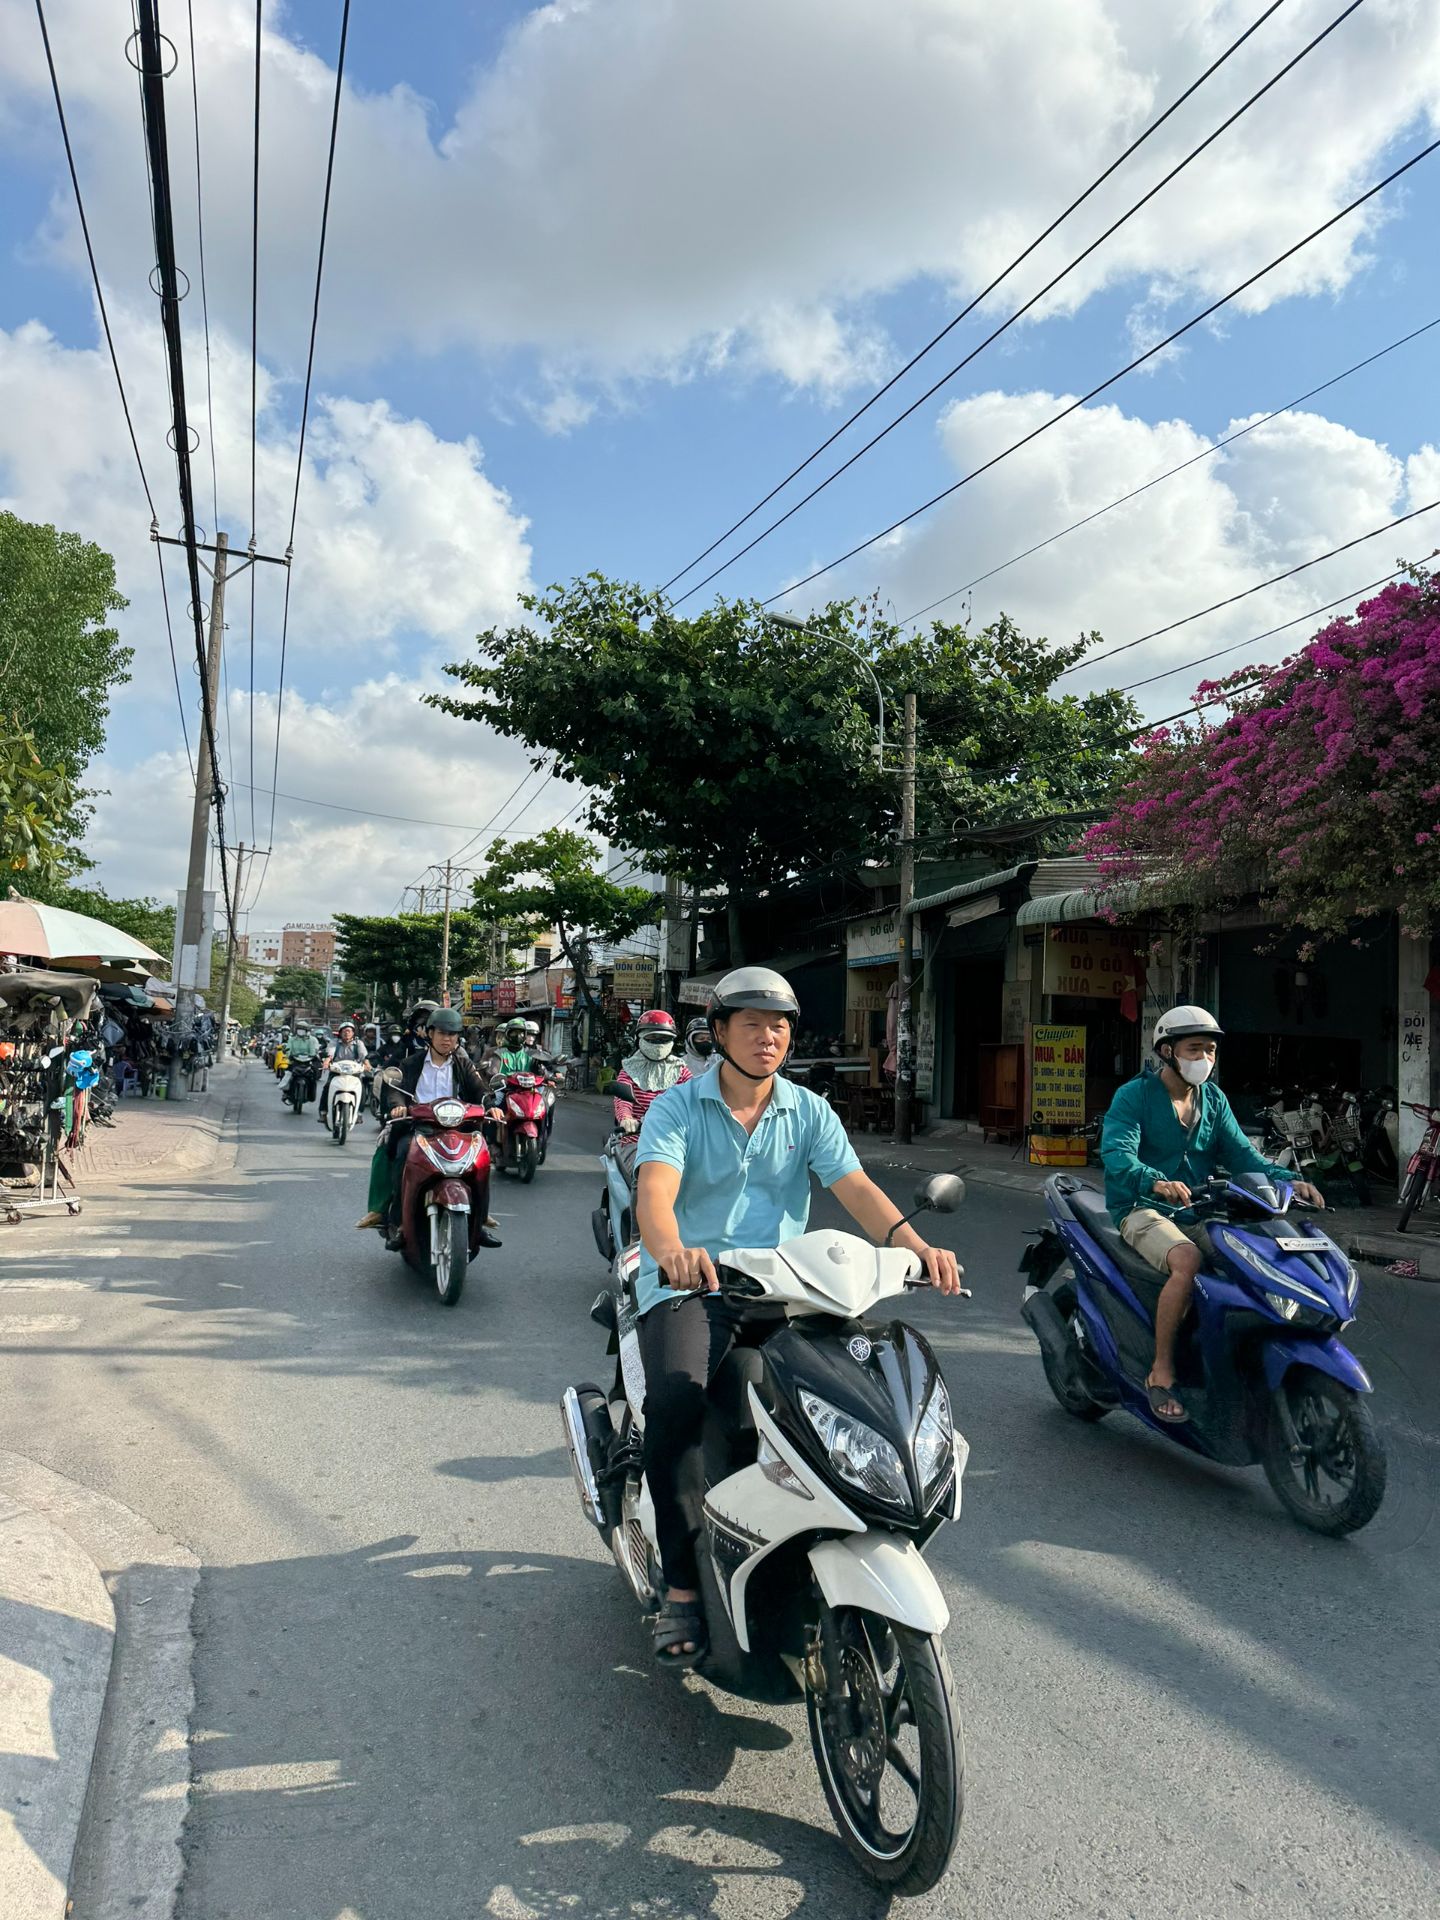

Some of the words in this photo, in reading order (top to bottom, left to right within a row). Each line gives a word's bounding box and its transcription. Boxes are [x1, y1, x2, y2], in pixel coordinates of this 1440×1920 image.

[286, 922, 315, 930] GAMUDA
[1035, 1046, 1055, 1063] MUA
[1064, 1045, 1085, 1064] BÁN
